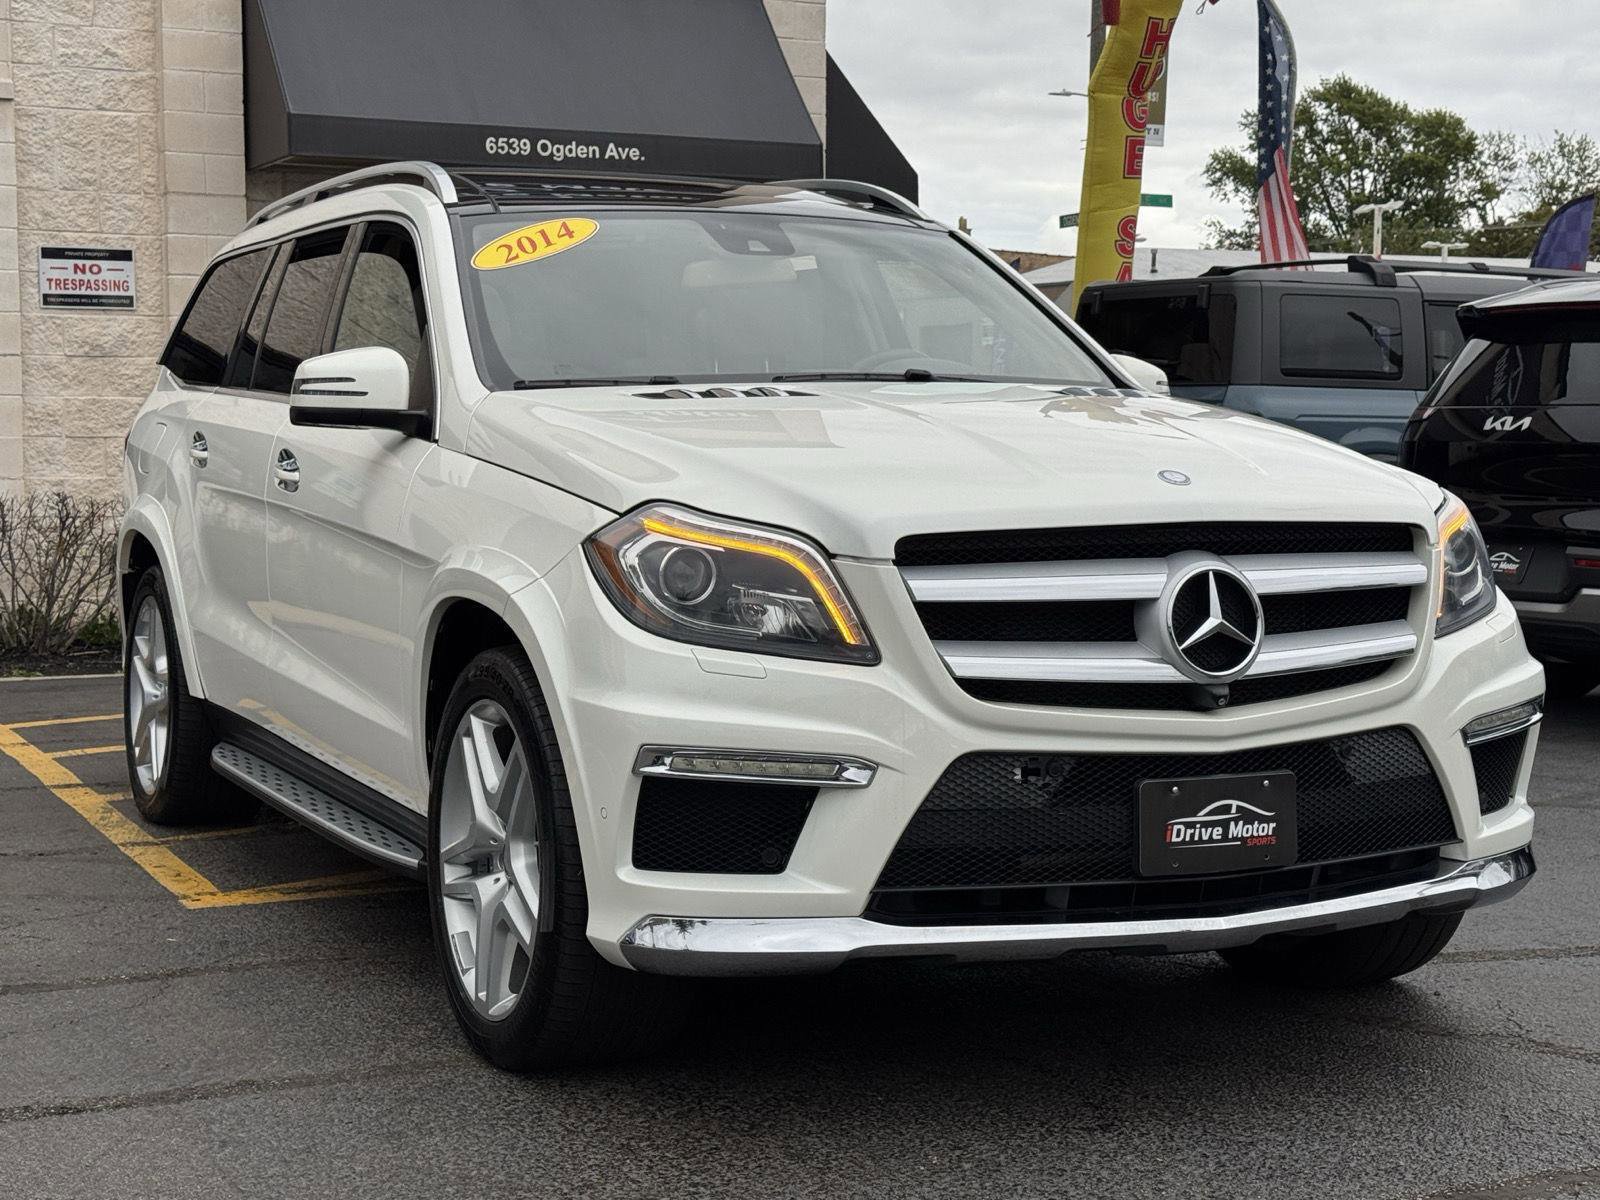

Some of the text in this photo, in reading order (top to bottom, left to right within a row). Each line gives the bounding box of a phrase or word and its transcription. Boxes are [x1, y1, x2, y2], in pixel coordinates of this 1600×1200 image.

[485, 137, 646, 161] 6539 Ogden Ave.
[496, 221, 575, 264] 2014
[73, 263, 102, 276] NO
[46, 278, 130, 292] TRESPASSING
[1483, 416, 1533, 431] KIA
[1165, 820, 1277, 843] iDrive Motor
[1246, 836, 1277, 847] SPORTS
